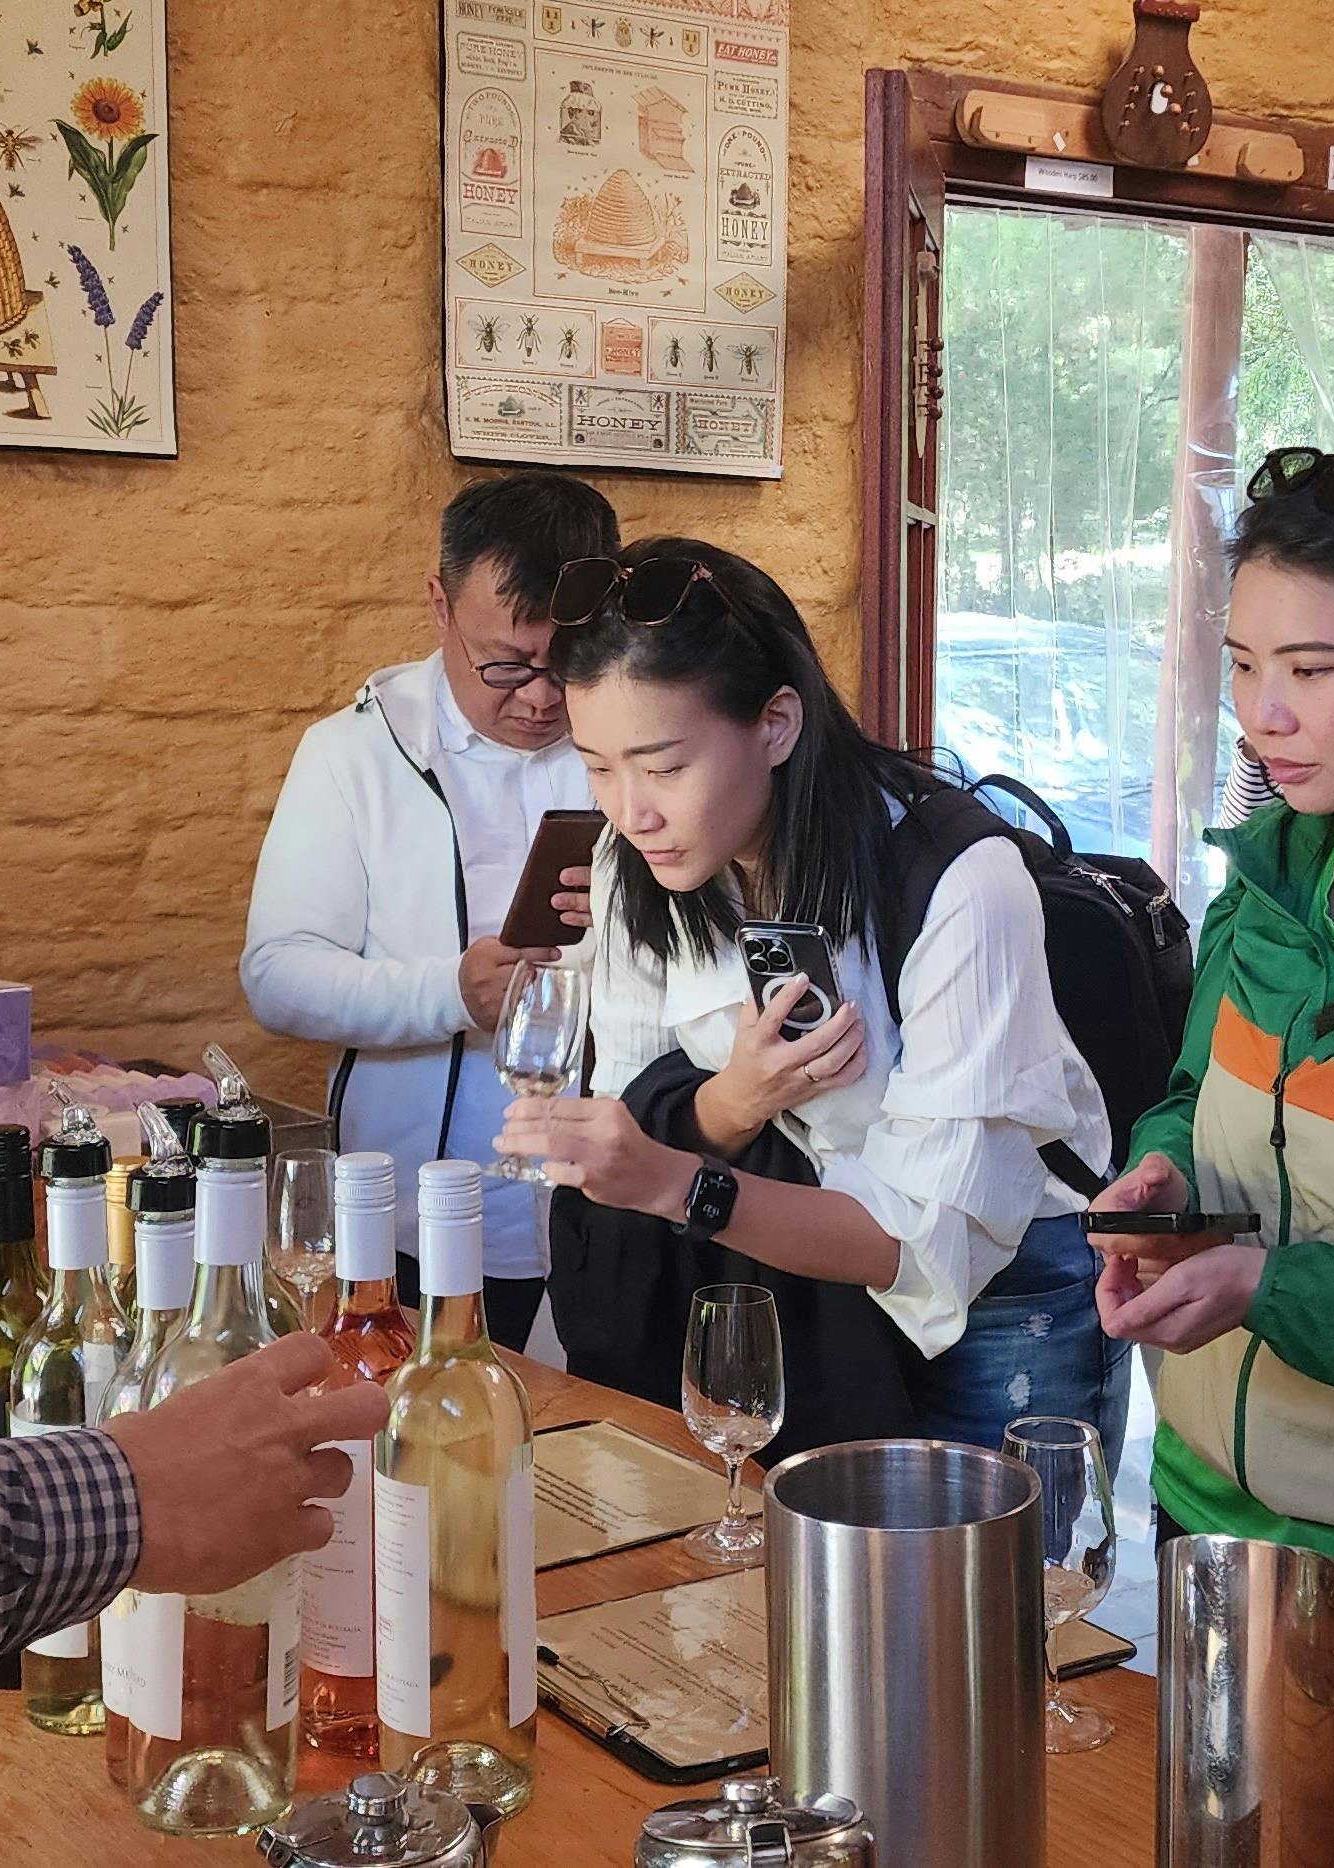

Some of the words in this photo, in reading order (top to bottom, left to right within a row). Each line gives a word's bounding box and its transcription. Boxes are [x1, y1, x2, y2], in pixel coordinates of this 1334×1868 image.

[718, 44, 738, 55] EAT
[738, 47, 773, 61] HONEY
[724, 132, 738, 150] ONE
[462, 182, 518, 204] HONEY
[721, 217, 768, 241] HONEY
[469, 258, 513, 273] HONEY
[725, 286, 764, 299] HONEY
[576, 414, 662, 431] HONEY
[696, 419, 752, 432] HONEY
